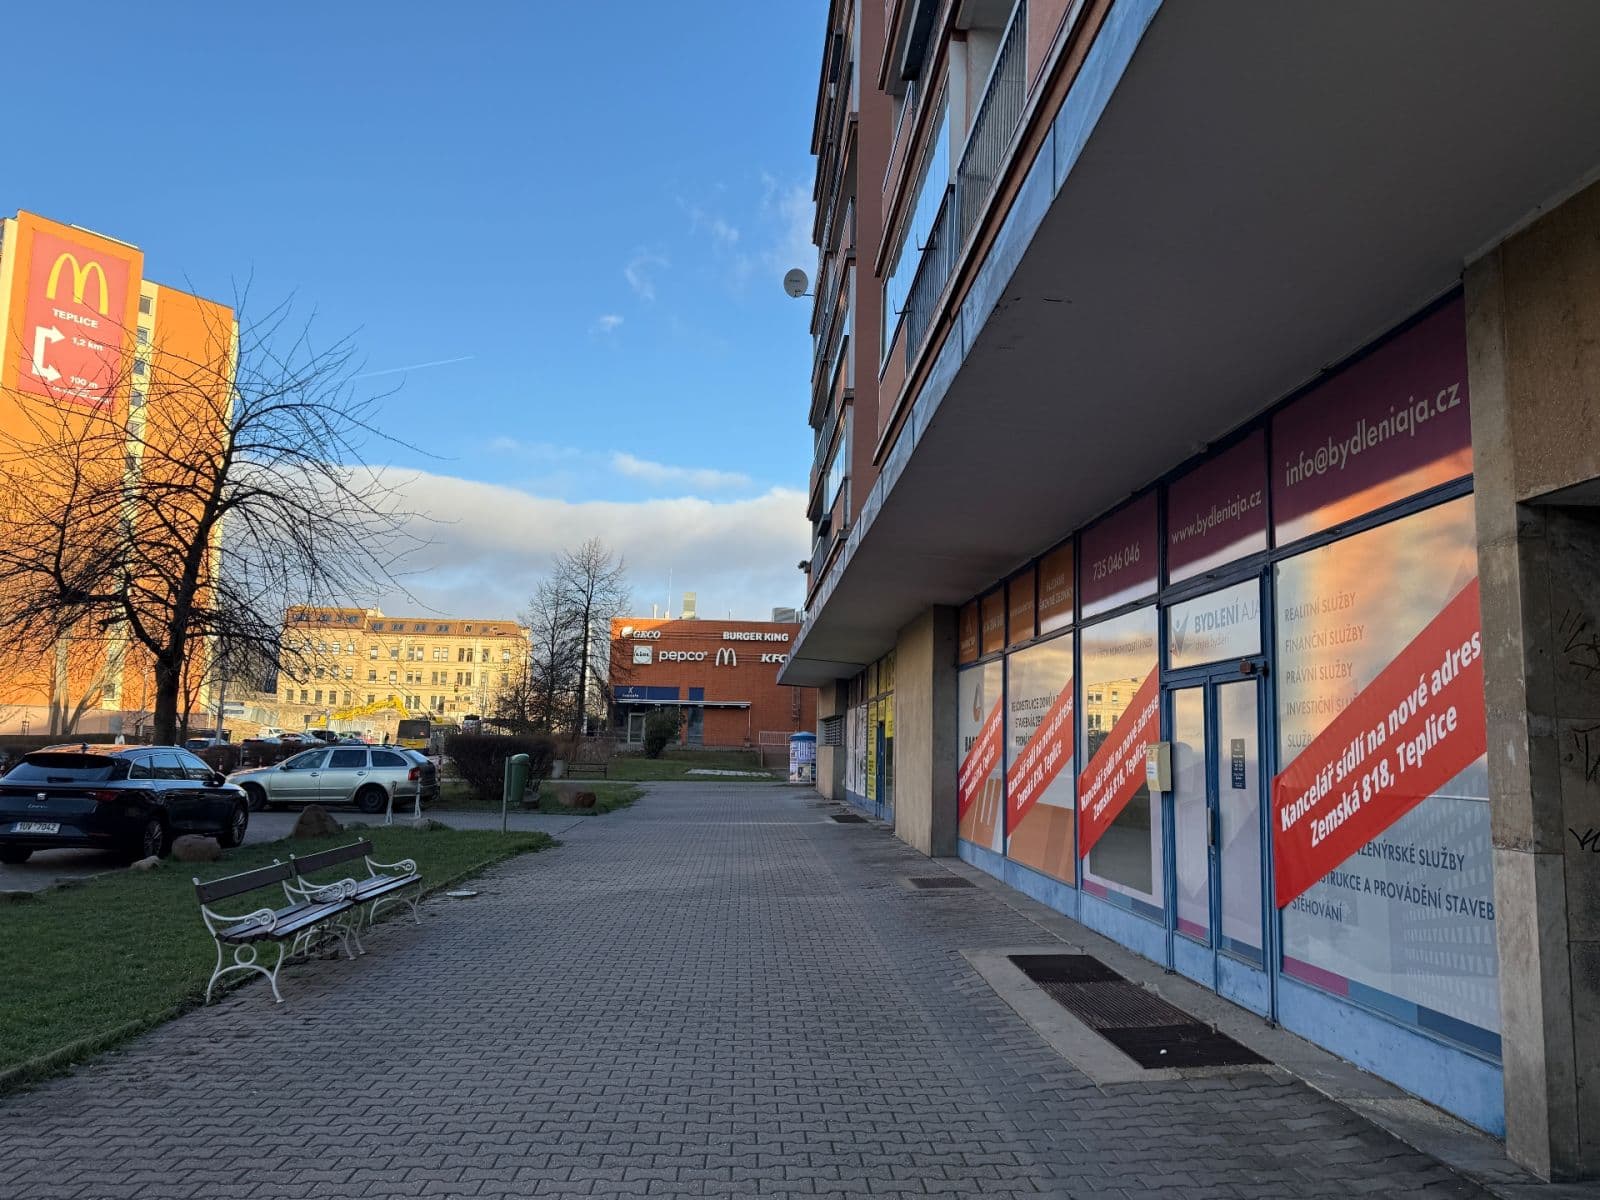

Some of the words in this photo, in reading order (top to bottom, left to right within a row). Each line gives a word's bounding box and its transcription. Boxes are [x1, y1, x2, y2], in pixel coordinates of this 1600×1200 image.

[52, 308, 99, 329] TEPLICE
[87, 340, 104, 351] km
[70, 375, 87, 386] 100
[1285, 382, 1461, 487] info@bydleniaja.cz
[1171, 489, 1262, 545] www.bydleniaja.cz
[1092, 561, 1107, 581] 735
[1107, 554, 1122, 574] 046
[1124, 542, 1140, 567] 046
[1194, 597, 1239, 634] BYDLENÍ
[1284, 598, 1320, 622] REALITNÍ
[1321, 591, 1357, 613] SLUŽBY
[722, 631, 762, 641] BURGER
[764, 632, 789, 642] KING
[1285, 628, 1327, 653] FINANČNÍ
[1329, 623, 1365, 645] SLUŽBY
[1286, 664, 1317, 685] PRÁVNÍ
[1319, 658, 1353, 680] SLUŽBY
[1286, 695, 1334, 717] INVESTIČNÍ
[1281, 761, 1334, 832] Kancelář
[1336, 731, 1366, 783] sídlí
[1367, 722, 1386, 755] na
[1388, 673, 1428, 736] nové
[1431, 631, 1481, 696] adres
[1125, 740, 1147, 777] Teplice
[1310, 781, 1361, 848] Zemská
[1363, 758, 1395, 804] 818,
[1396, 706, 1457, 773] Teplice
[1418, 845, 1465, 872] SLUŽBY
[1291, 894, 1342, 923] STĚHOVÁNÍ
[1363, 877, 1371, 893] A
[1374, 880, 1442, 909] PROVÁDĚNÍ
[1445, 894, 1495, 921] STAVEB
